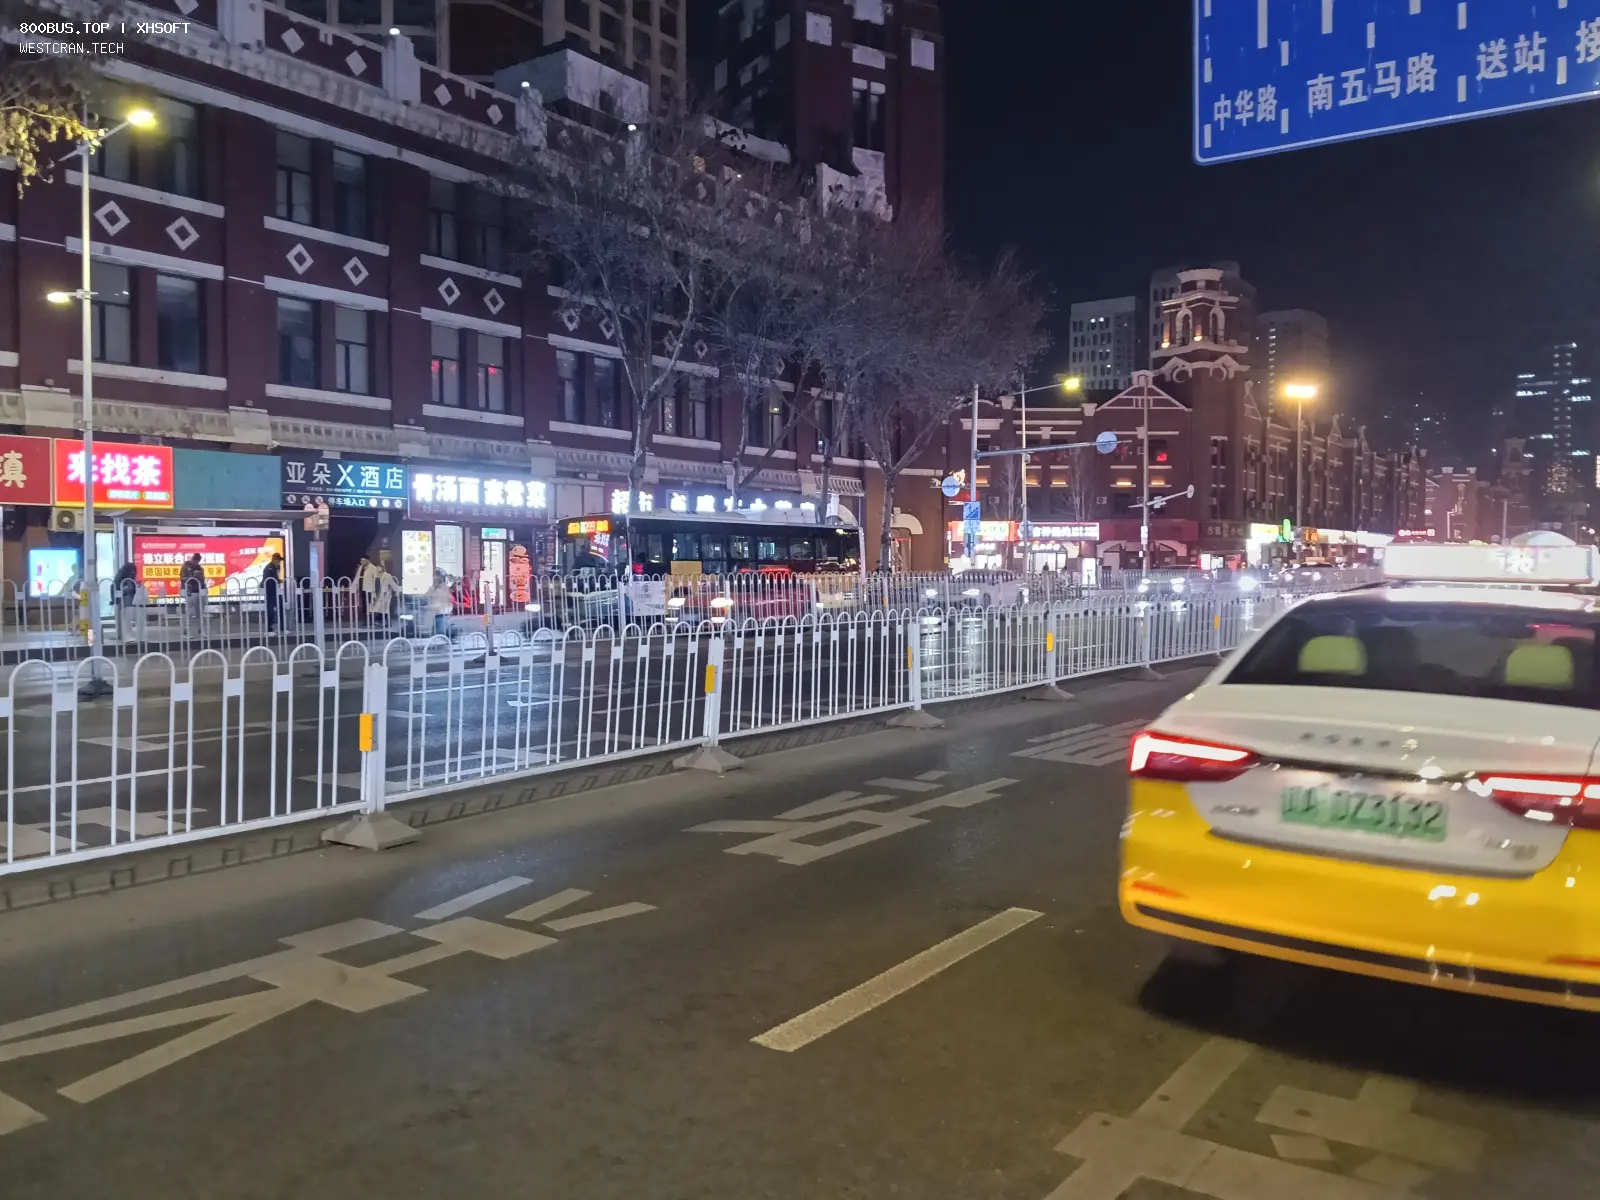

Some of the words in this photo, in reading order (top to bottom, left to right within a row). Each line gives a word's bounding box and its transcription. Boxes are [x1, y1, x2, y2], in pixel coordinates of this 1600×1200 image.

[1476, 31, 1546, 81] 送站
[1307, 52, 1437, 115] 南五马路
[1213, 84, 1278, 131] 中华路
[286, 461, 403, 490] 亚朵X酒店
[328, 496, 366, 507] 停车场入口
